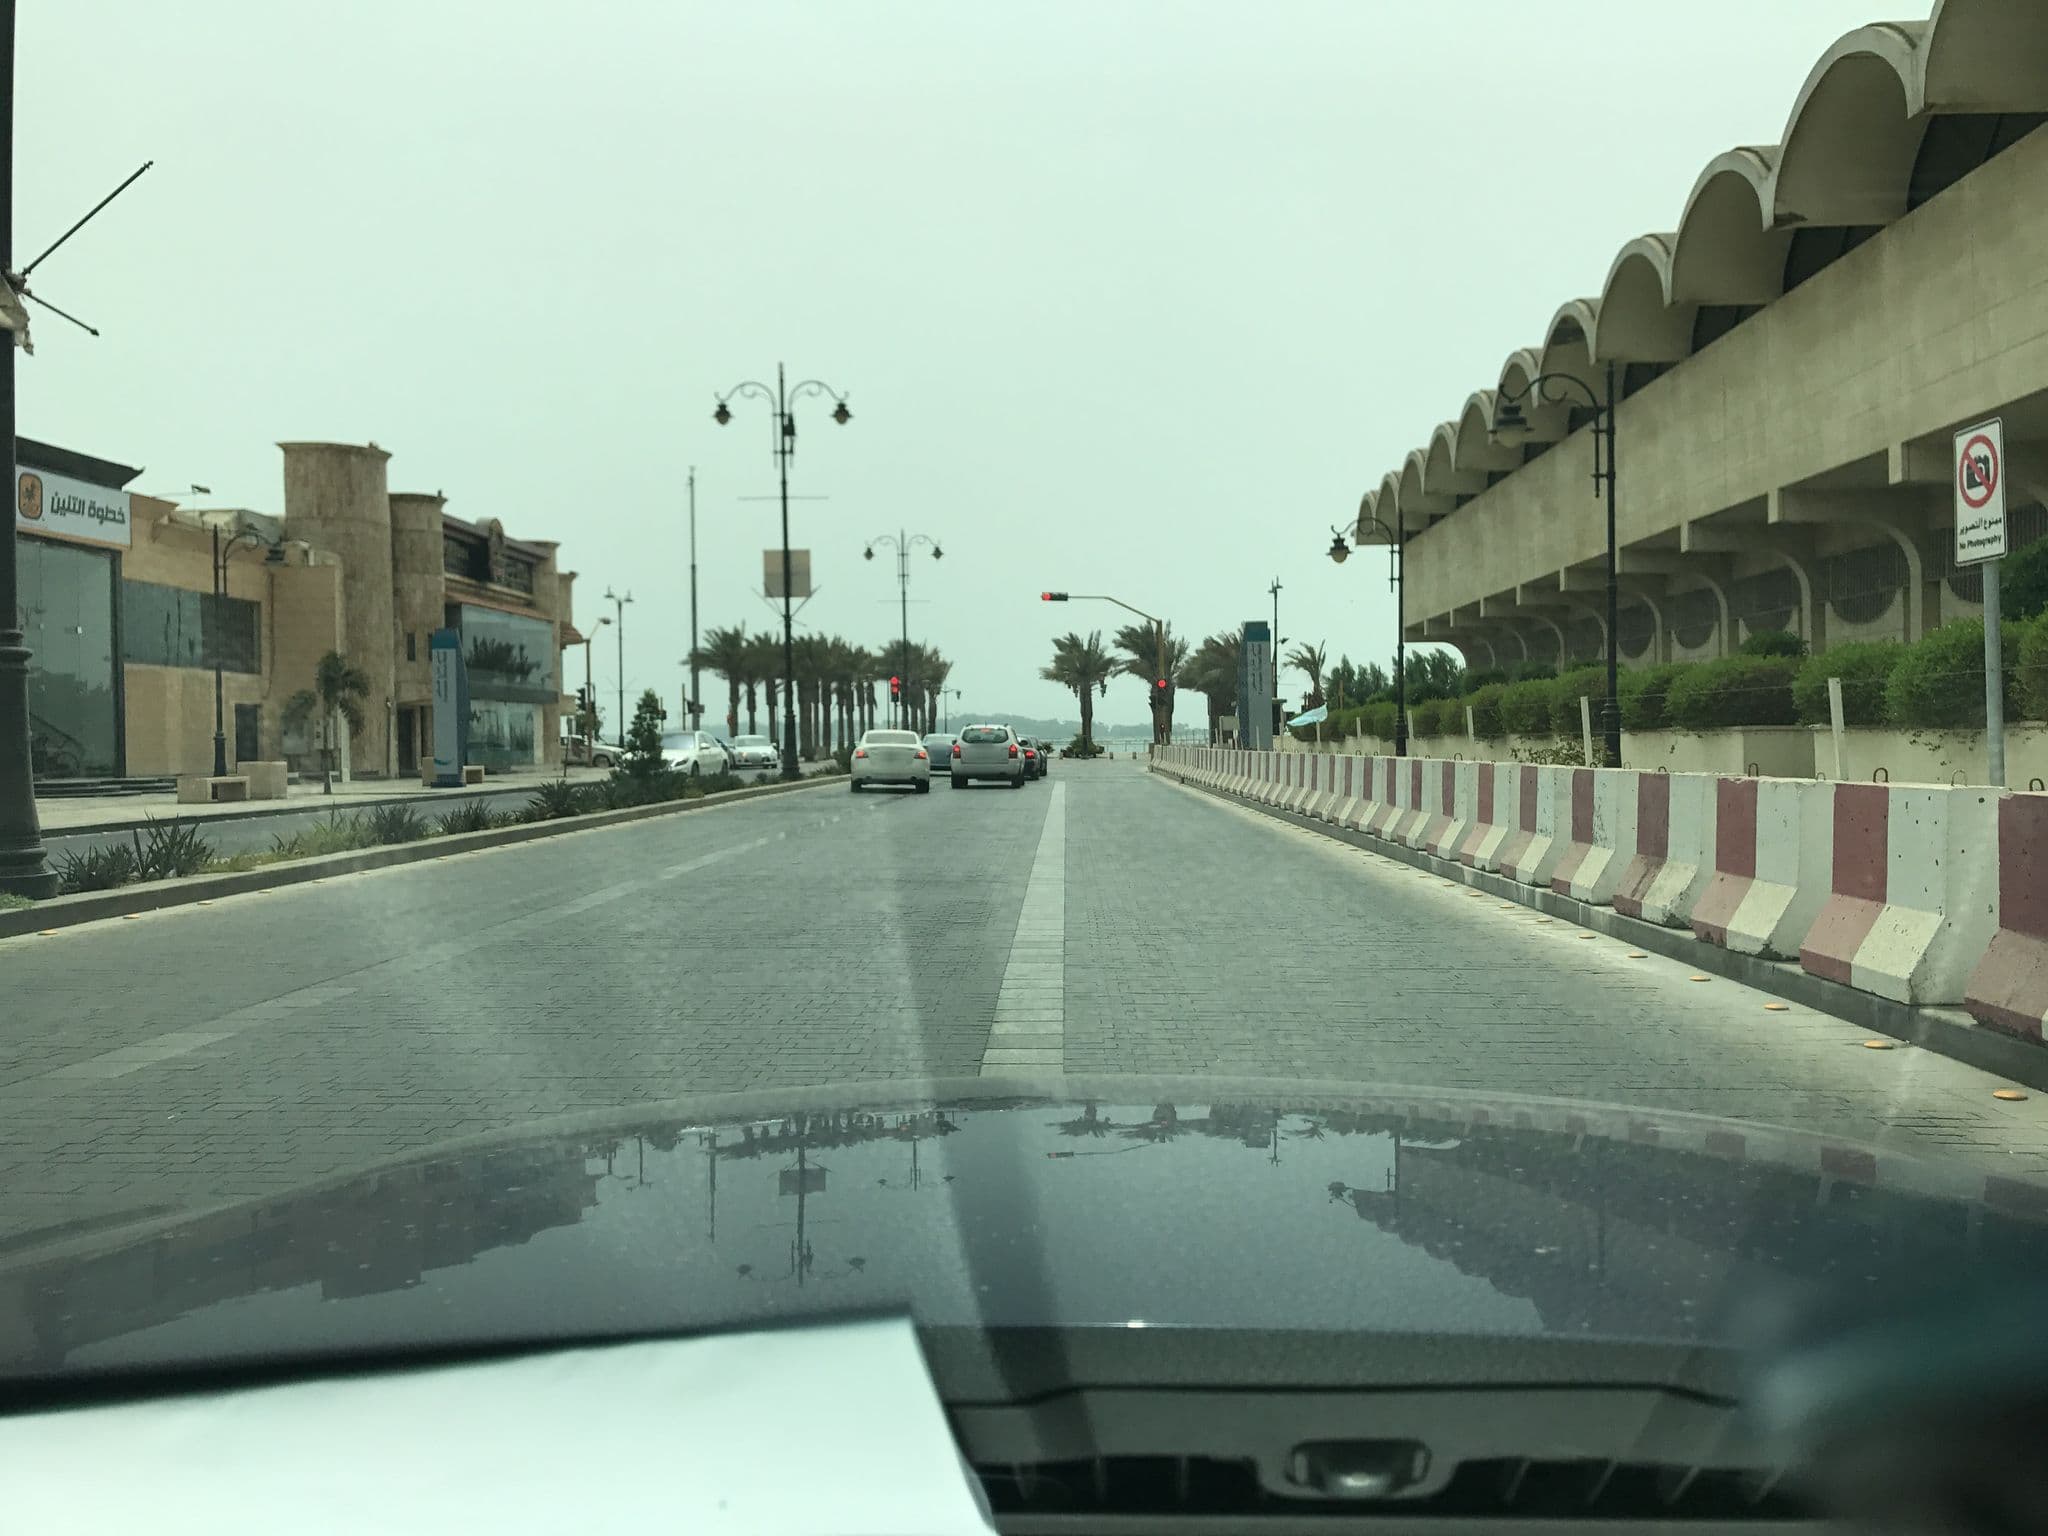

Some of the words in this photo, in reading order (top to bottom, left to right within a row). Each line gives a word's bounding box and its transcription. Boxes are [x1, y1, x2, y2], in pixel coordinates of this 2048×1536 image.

[87, 500, 126, 525] خطوة
[1959, 516, 1983, 536] التصوير
[1983, 517, 2002, 531] ممنوع
[1959, 542, 1966, 550] No
[1967, 534, 2002, 549] Photography
